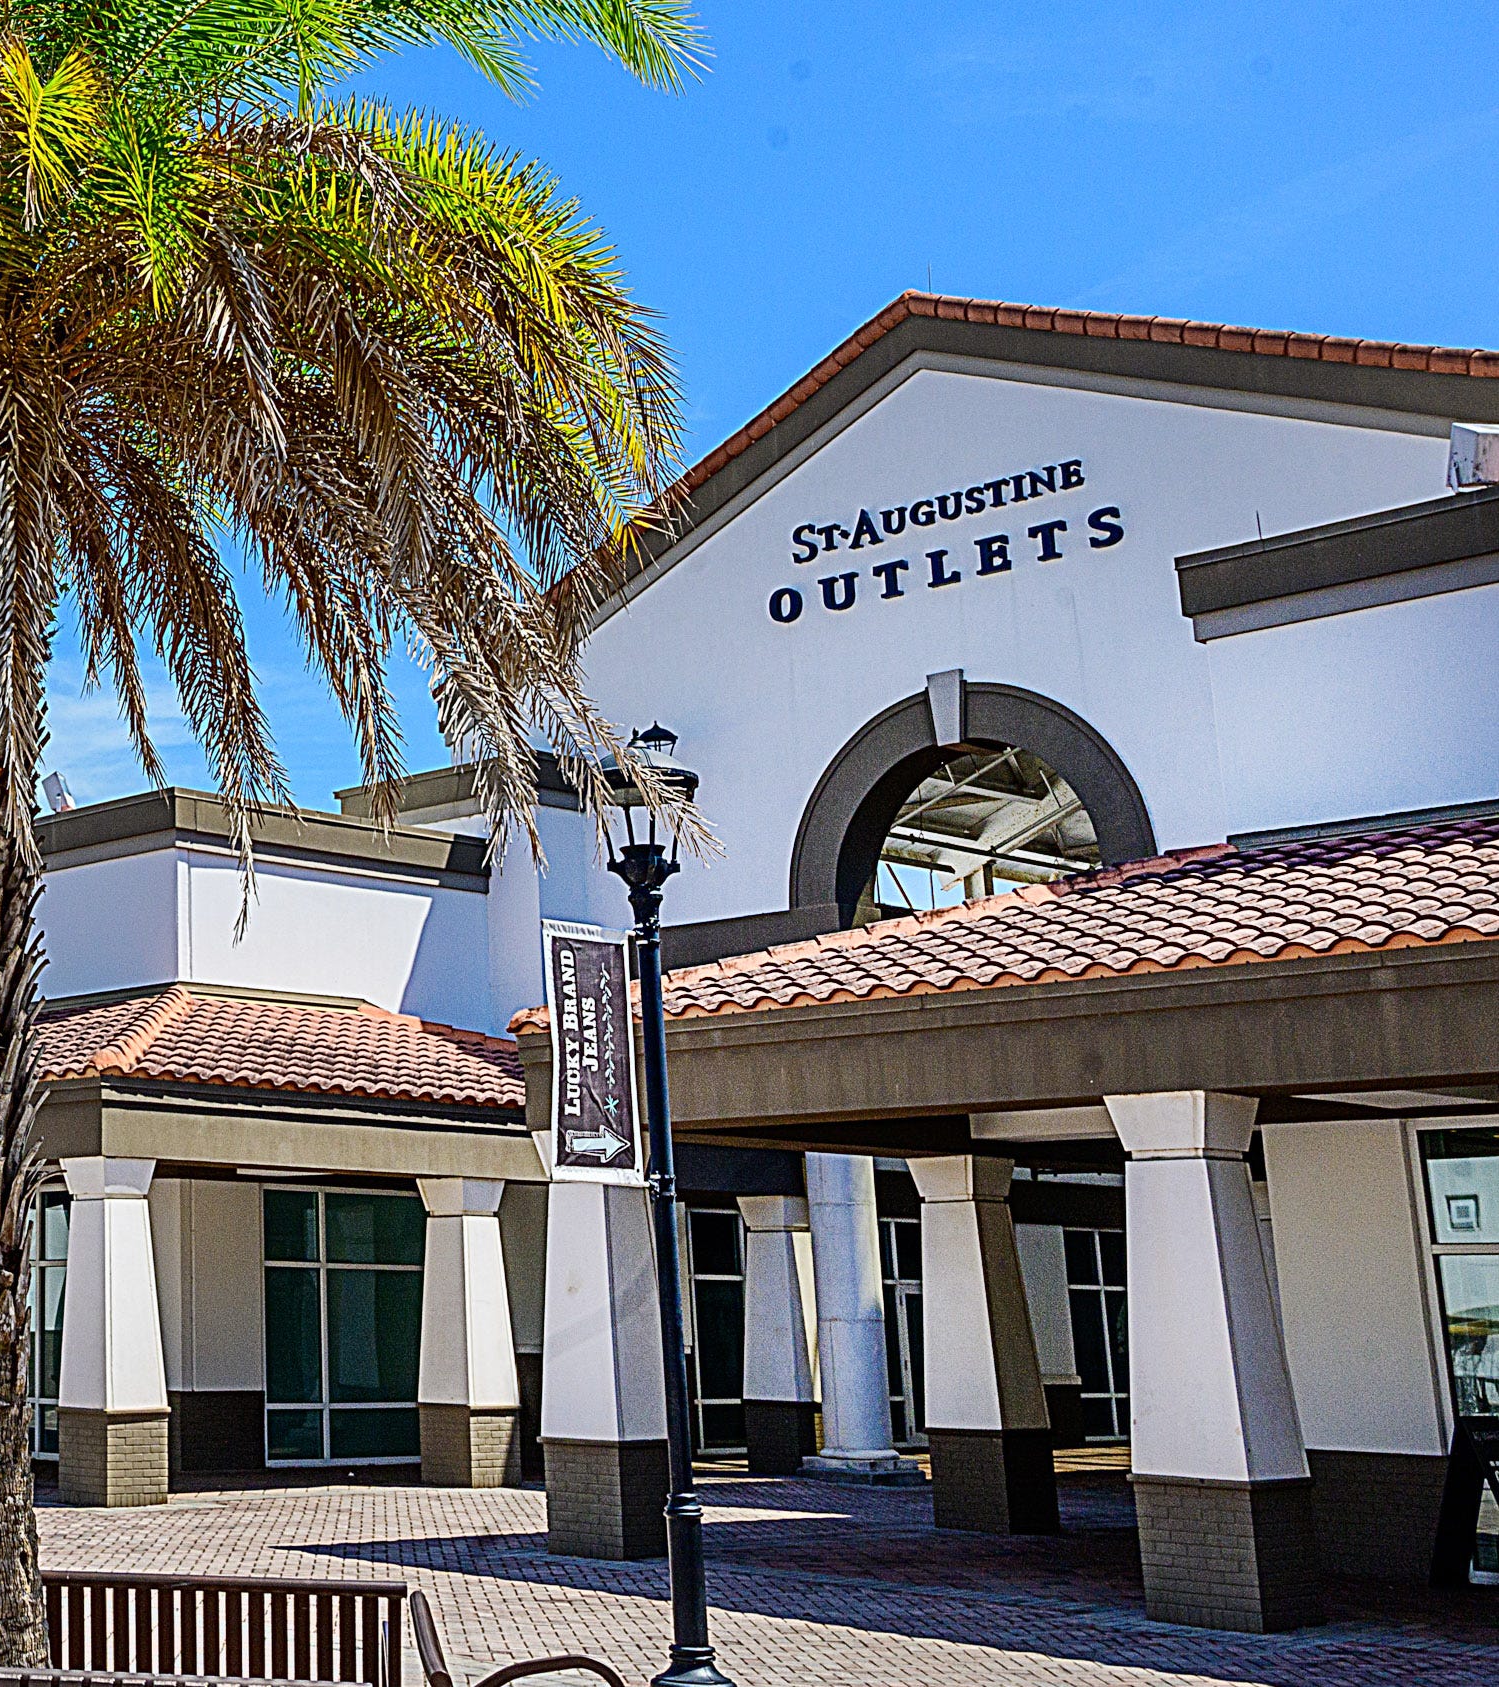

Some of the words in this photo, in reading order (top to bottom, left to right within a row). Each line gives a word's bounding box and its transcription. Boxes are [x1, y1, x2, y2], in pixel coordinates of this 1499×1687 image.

[848, 459, 1086, 550] AUGUSTINE
[768, 506, 1125, 623] OUTLETS
[559, 949, 580, 1032] BRAND
[581, 996, 599, 1073] JEANS
[564, 1036, 582, 1117] LUCKY
